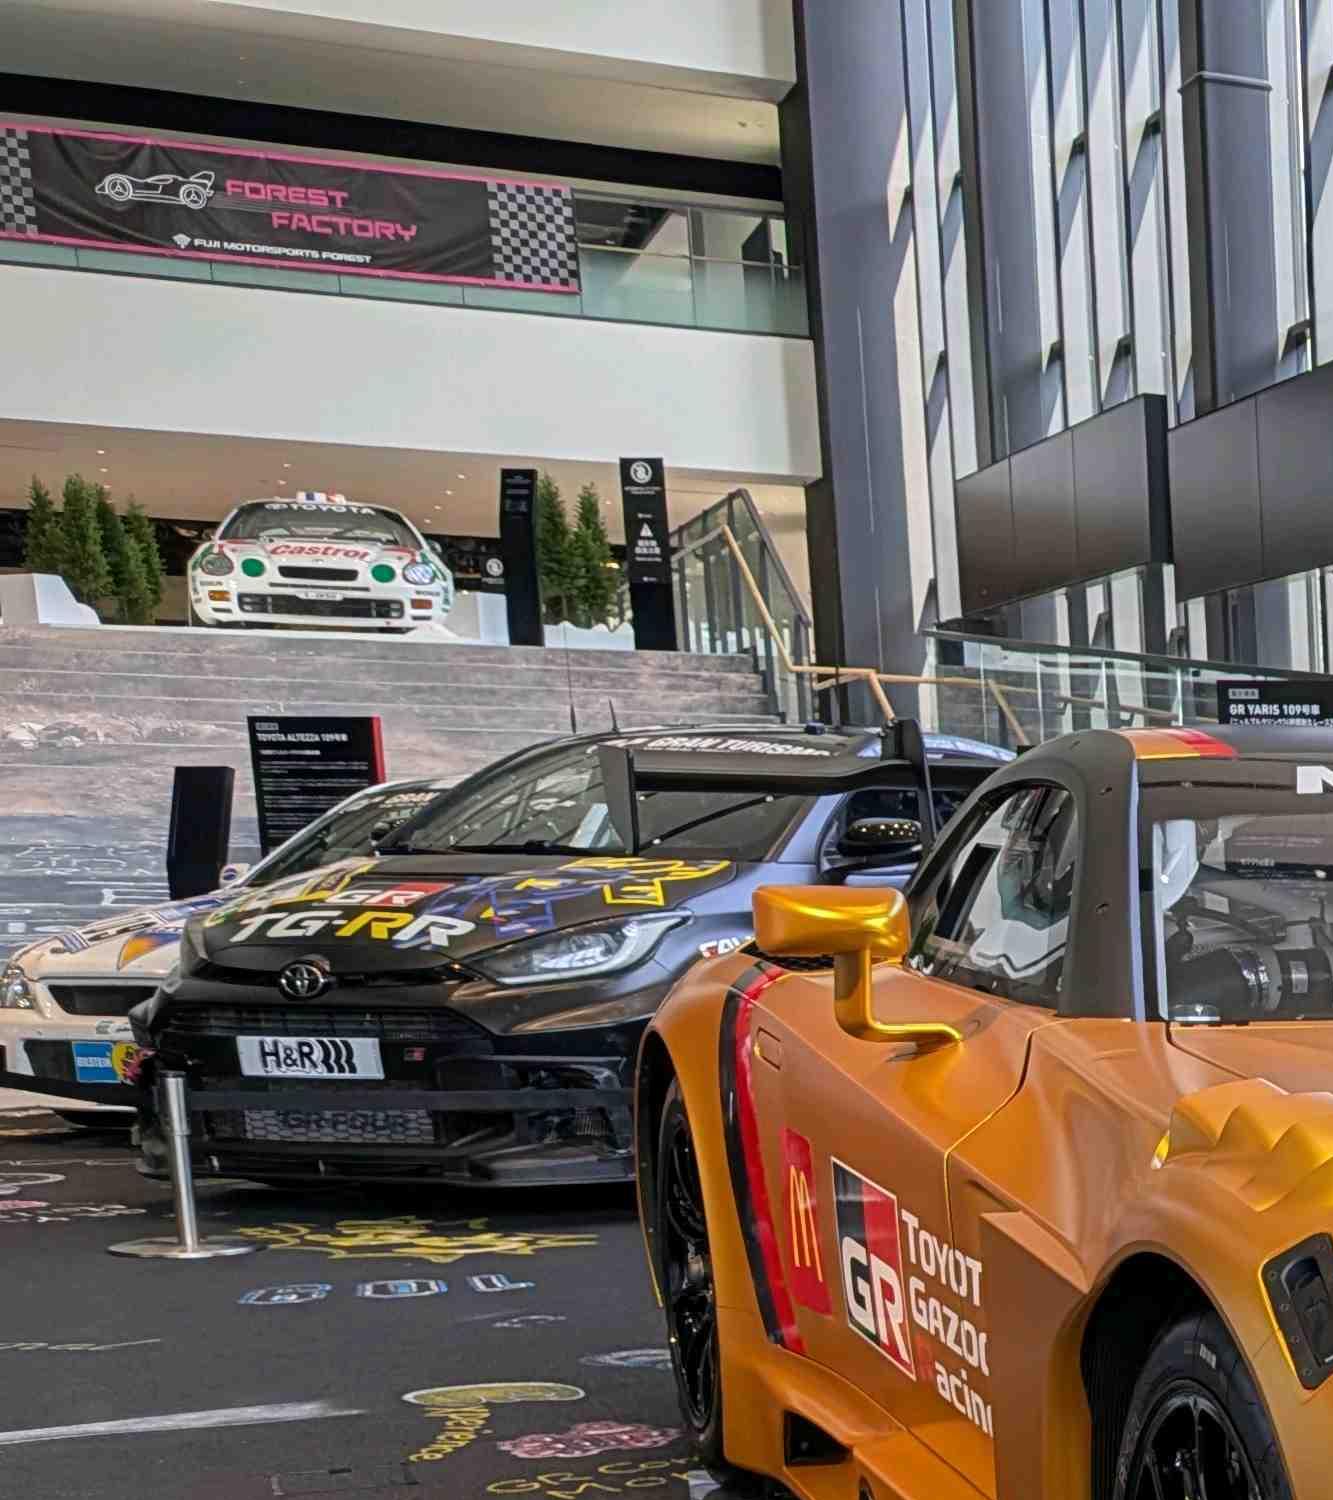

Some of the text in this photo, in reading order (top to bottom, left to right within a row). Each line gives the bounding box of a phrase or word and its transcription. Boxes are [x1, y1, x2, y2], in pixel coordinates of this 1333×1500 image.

[225, 179, 349, 208] FOREST
[271, 211, 416, 241] FACTORY
[193, 238, 372, 264] FUJI MOTORSPORTS FOREST
[290, 503, 376, 516] TOYOTA
[1229, 704, 1245, 715] GR
[1247, 704, 1280, 715] YARIS
[229, 911, 476, 948] TG-RR
[259, 1040, 319, 1070] H&R
[901, 1208, 983, 1308] TOYOT
[842, 1236, 912, 1365] GR
